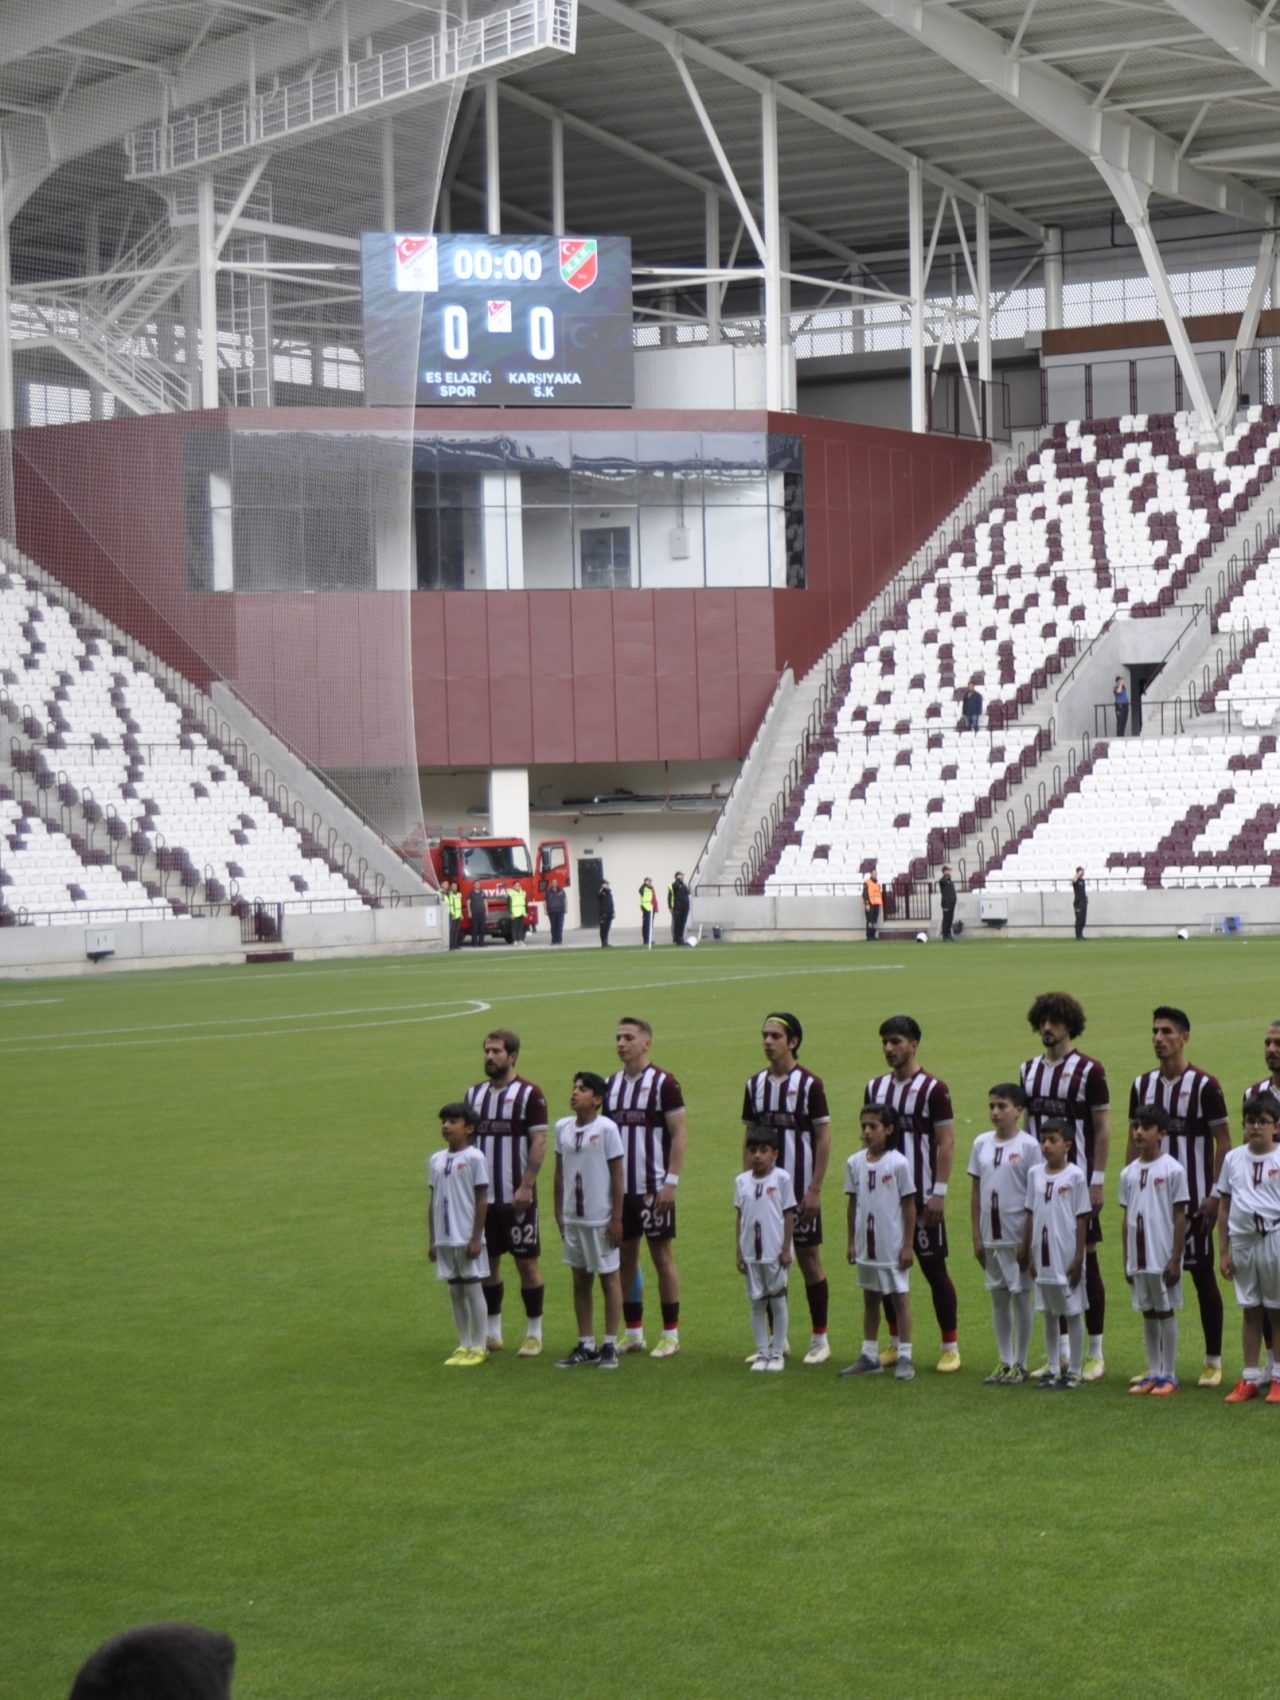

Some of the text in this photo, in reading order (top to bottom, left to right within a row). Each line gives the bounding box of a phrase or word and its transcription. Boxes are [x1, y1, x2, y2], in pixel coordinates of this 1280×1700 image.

[453, 249, 543, 281] 00:00
[443, 305, 469, 360] 0
[530, 306, 555, 361] 0
[425, 370, 492, 384] ES ELAZIĞ
[508, 371, 582, 386] KARŞIYAKA
[440, 385, 476, 398] SPOR
[511, 1223, 534, 1245] 92
